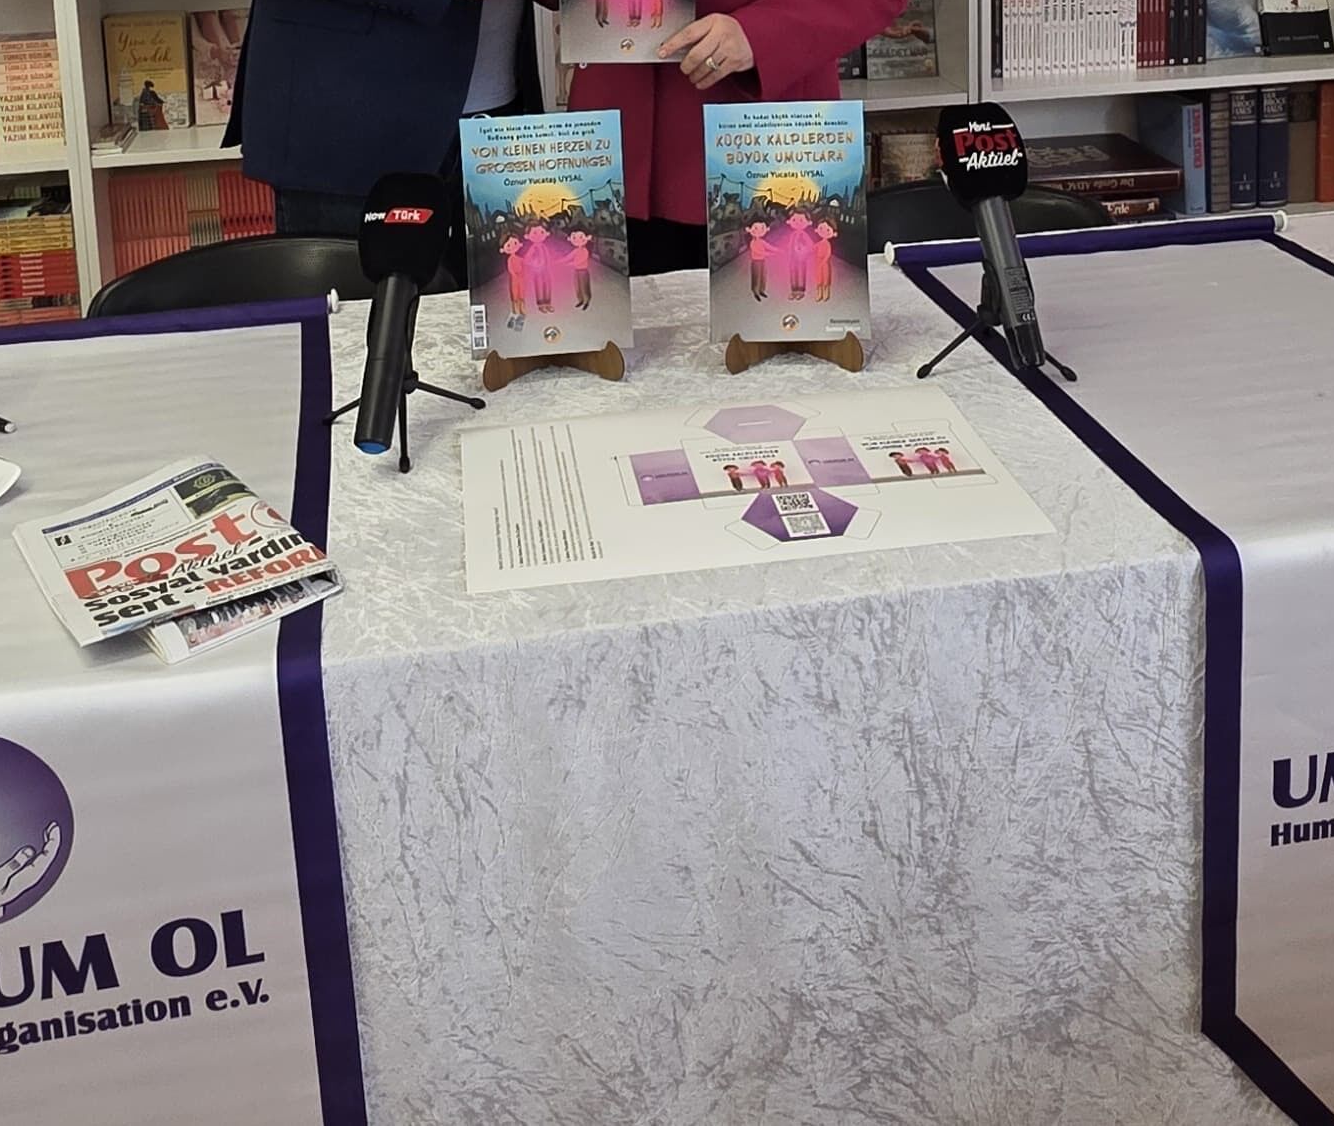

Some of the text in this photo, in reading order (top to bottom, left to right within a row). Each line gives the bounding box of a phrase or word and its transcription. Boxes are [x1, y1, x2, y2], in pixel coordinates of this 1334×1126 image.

[0, 95, 23, 103] YAZIM
[0, 104, 24, 112] YAZIM
[1, 115, 25, 123] YAZIM
[969, 121, 991, 132] Yeni
[2, 125, 26, 133] YAZIM
[3, 134, 26, 142] YAZIM
[716, 131, 854, 149] KÜÇÜK KALPLERDEN
[954, 129, 1017, 156] Post
[471, 139, 611, 159] VON KLEINEN HERZEN ZU
[476, 155, 612, 174] GROSSEN HOFFNUNGEN
[726, 150, 844, 165] BÜYÜK UMUTLARA
[967, 148, 1019, 171] Aktüel
[558, 174, 583, 183] UYSAL
[393, 210, 420, 221] Türk
[92, 593, 181, 627] sert
[149, 910, 265, 978] OL
[205, 978, 270, 1013] e.V.
